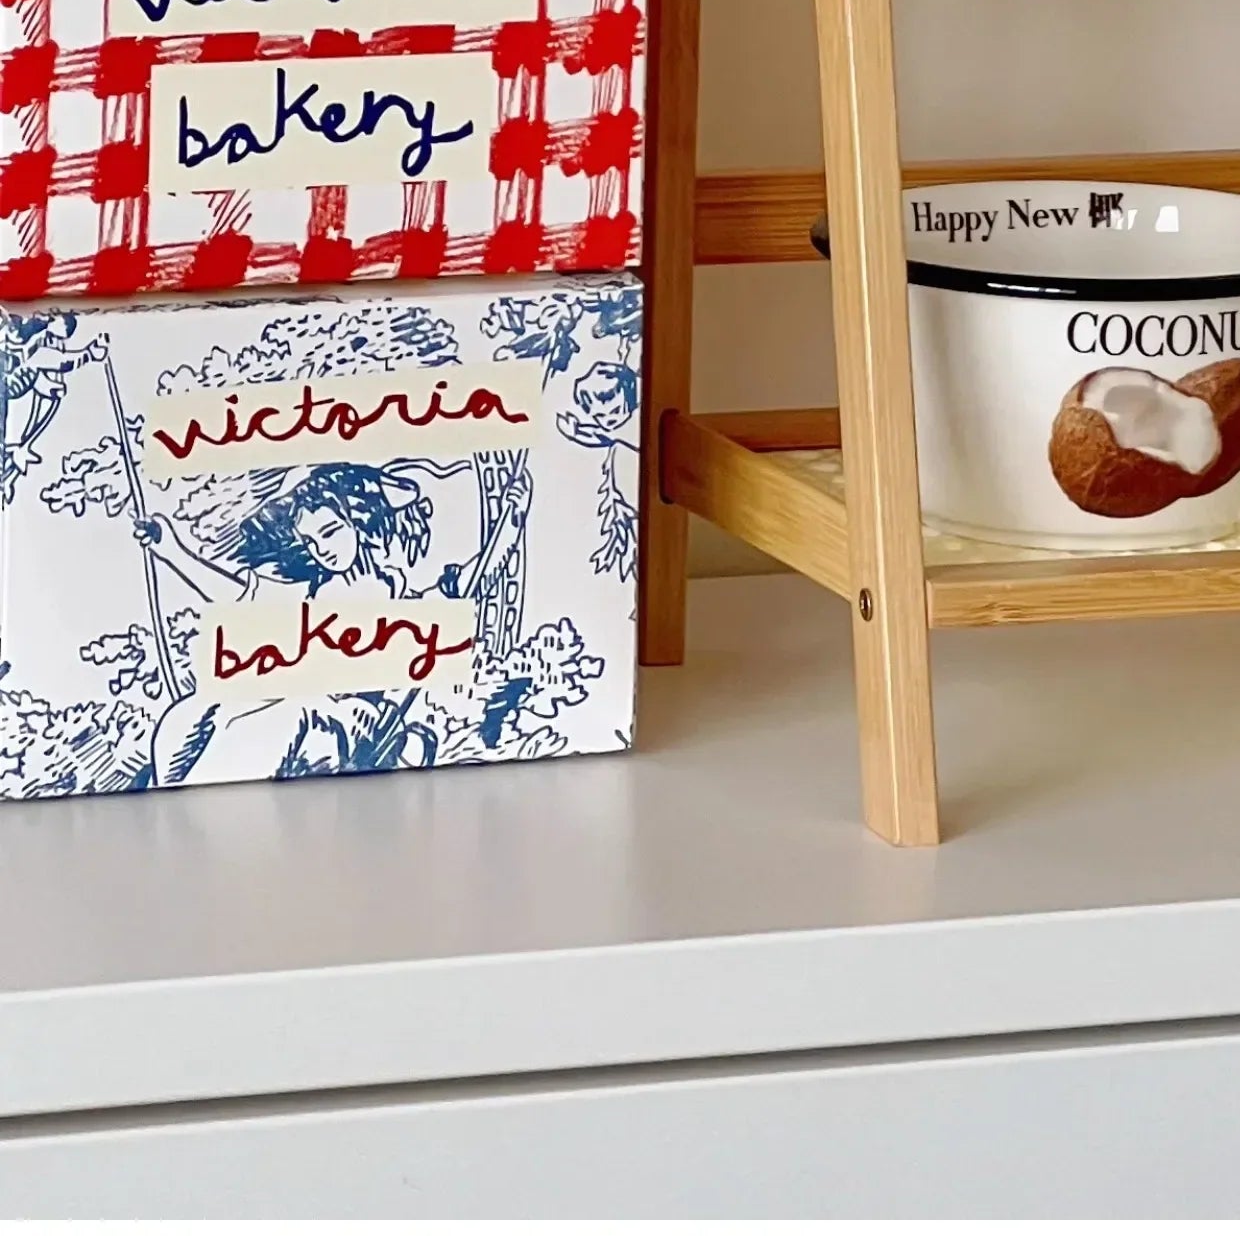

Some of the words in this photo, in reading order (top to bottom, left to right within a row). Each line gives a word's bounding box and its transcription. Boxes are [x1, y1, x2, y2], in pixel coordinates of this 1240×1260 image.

[178, 67, 474, 177] bakery
[911, 201, 999, 243] Happy
[1006, 198, 1080, 230] New
[152, 380, 530, 460] victoria
[213, 603, 474, 683] bakery
